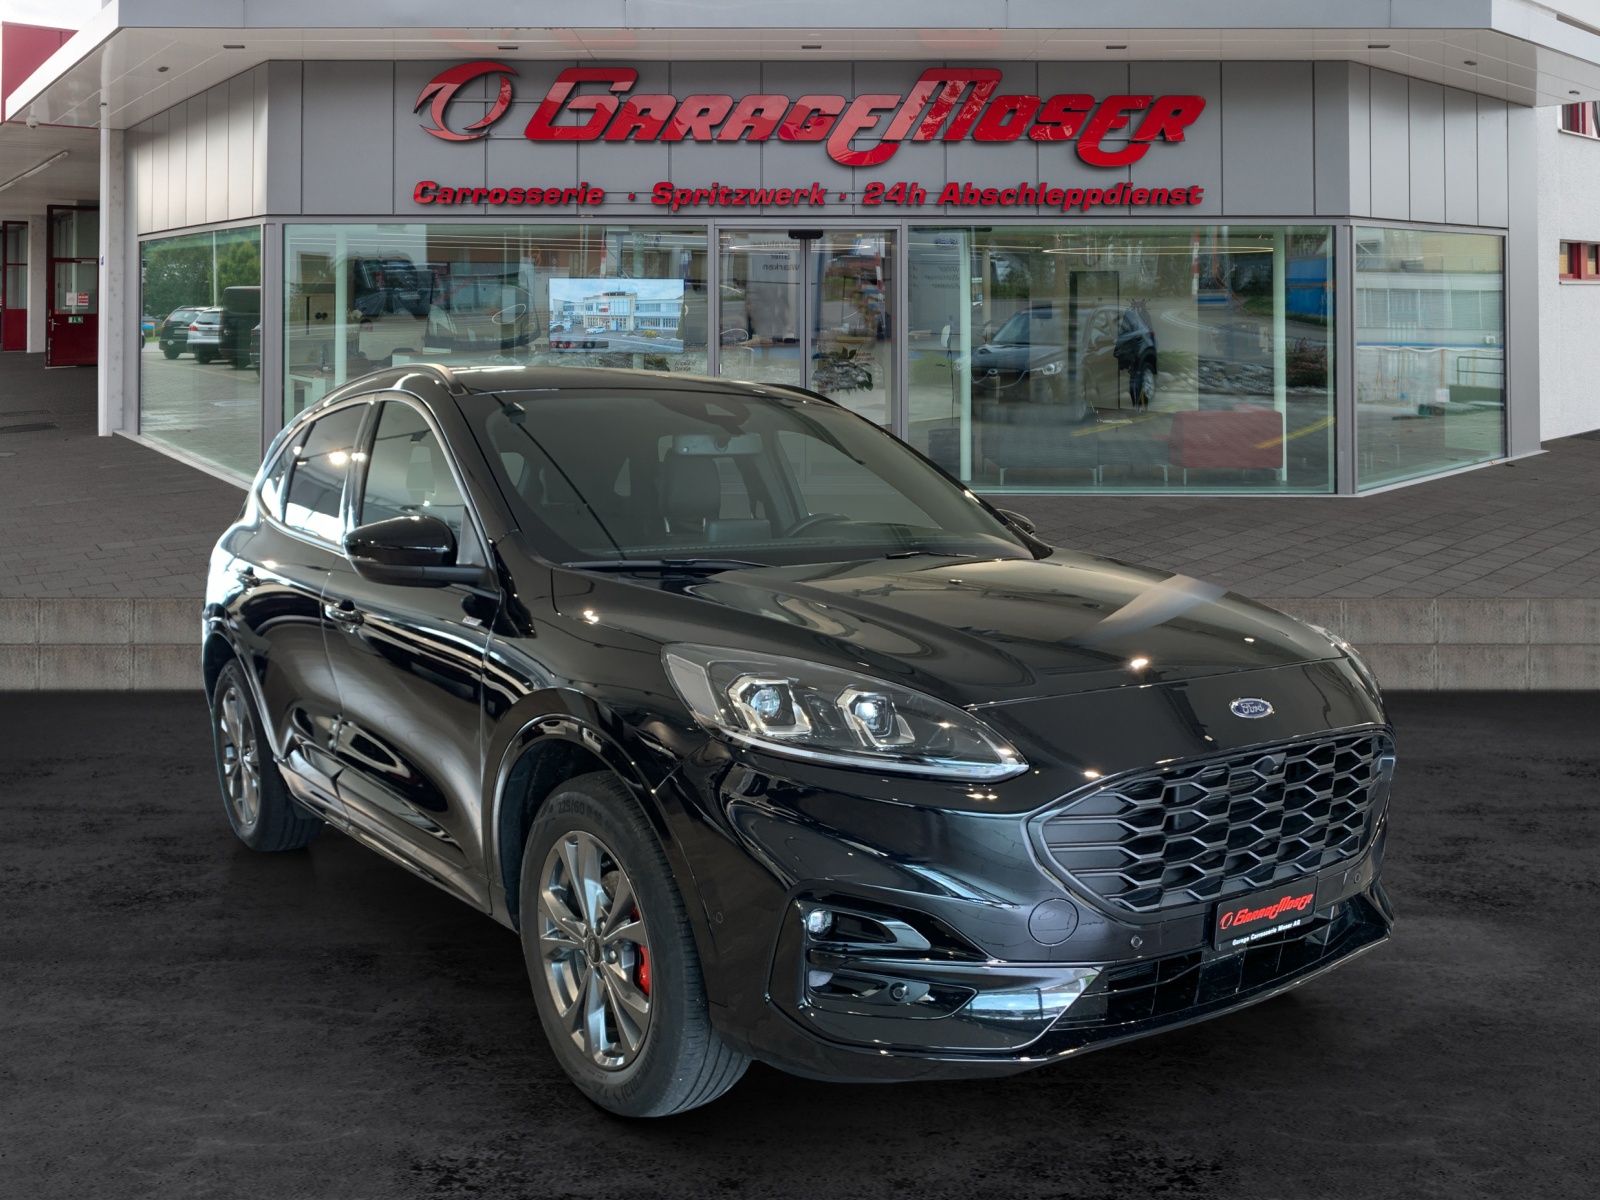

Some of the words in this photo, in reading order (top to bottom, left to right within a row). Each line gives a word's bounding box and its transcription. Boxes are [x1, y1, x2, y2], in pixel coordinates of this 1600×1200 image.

[413, 181, 604, 205] Carrosserie
[651, 181, 828, 211] Spritzwerk
[862, 182, 927, 206] 24h
[937, 182, 1205, 212] Abschleppdienst
[1240, 702, 1265, 715] Ford
